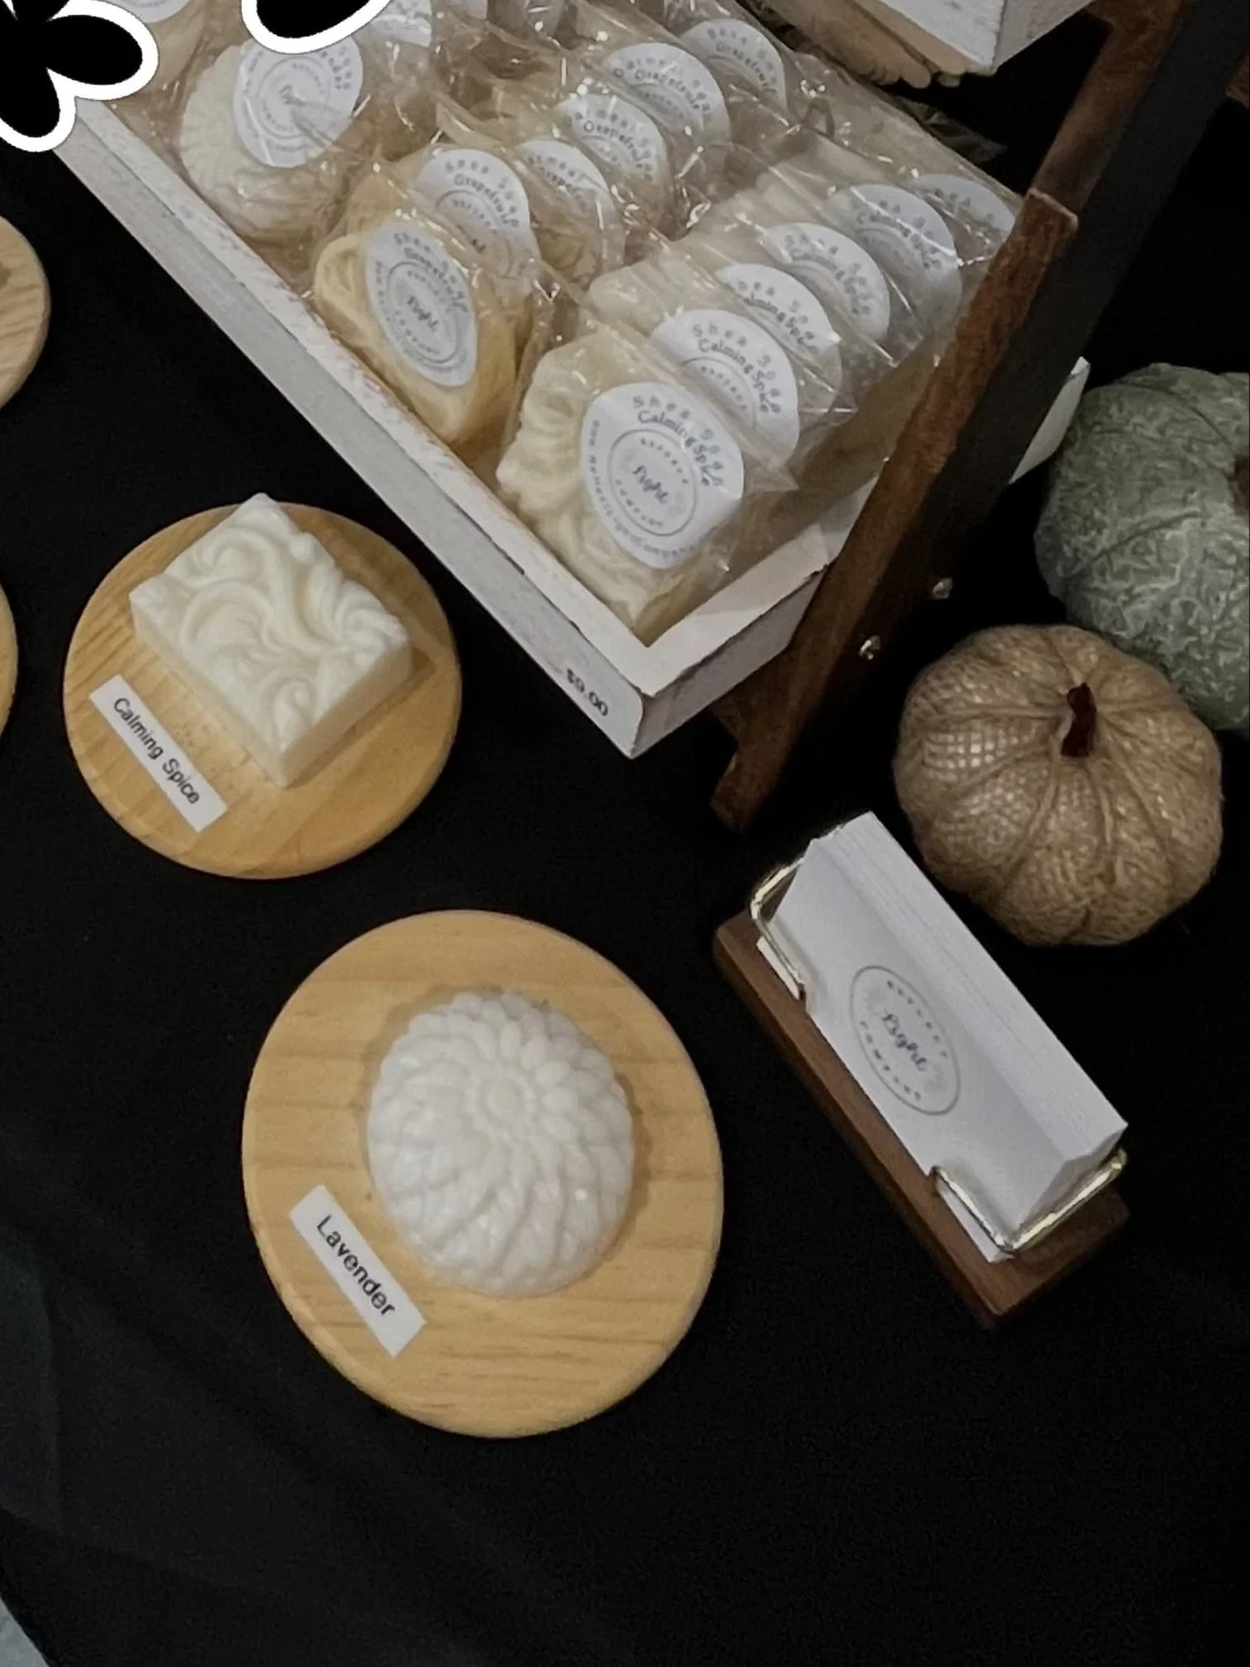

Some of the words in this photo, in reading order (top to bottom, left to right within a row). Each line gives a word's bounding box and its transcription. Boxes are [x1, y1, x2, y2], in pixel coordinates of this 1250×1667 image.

[743, 291, 786, 324] alming
[698, 337, 754, 375] Calming
[637, 410, 697, 448] Calming
[631, 464, 670, 505] Light
[113, 697, 164, 761] Calming
[161, 757, 201, 805] Spice
[316, 1213, 396, 1317] Lavender
